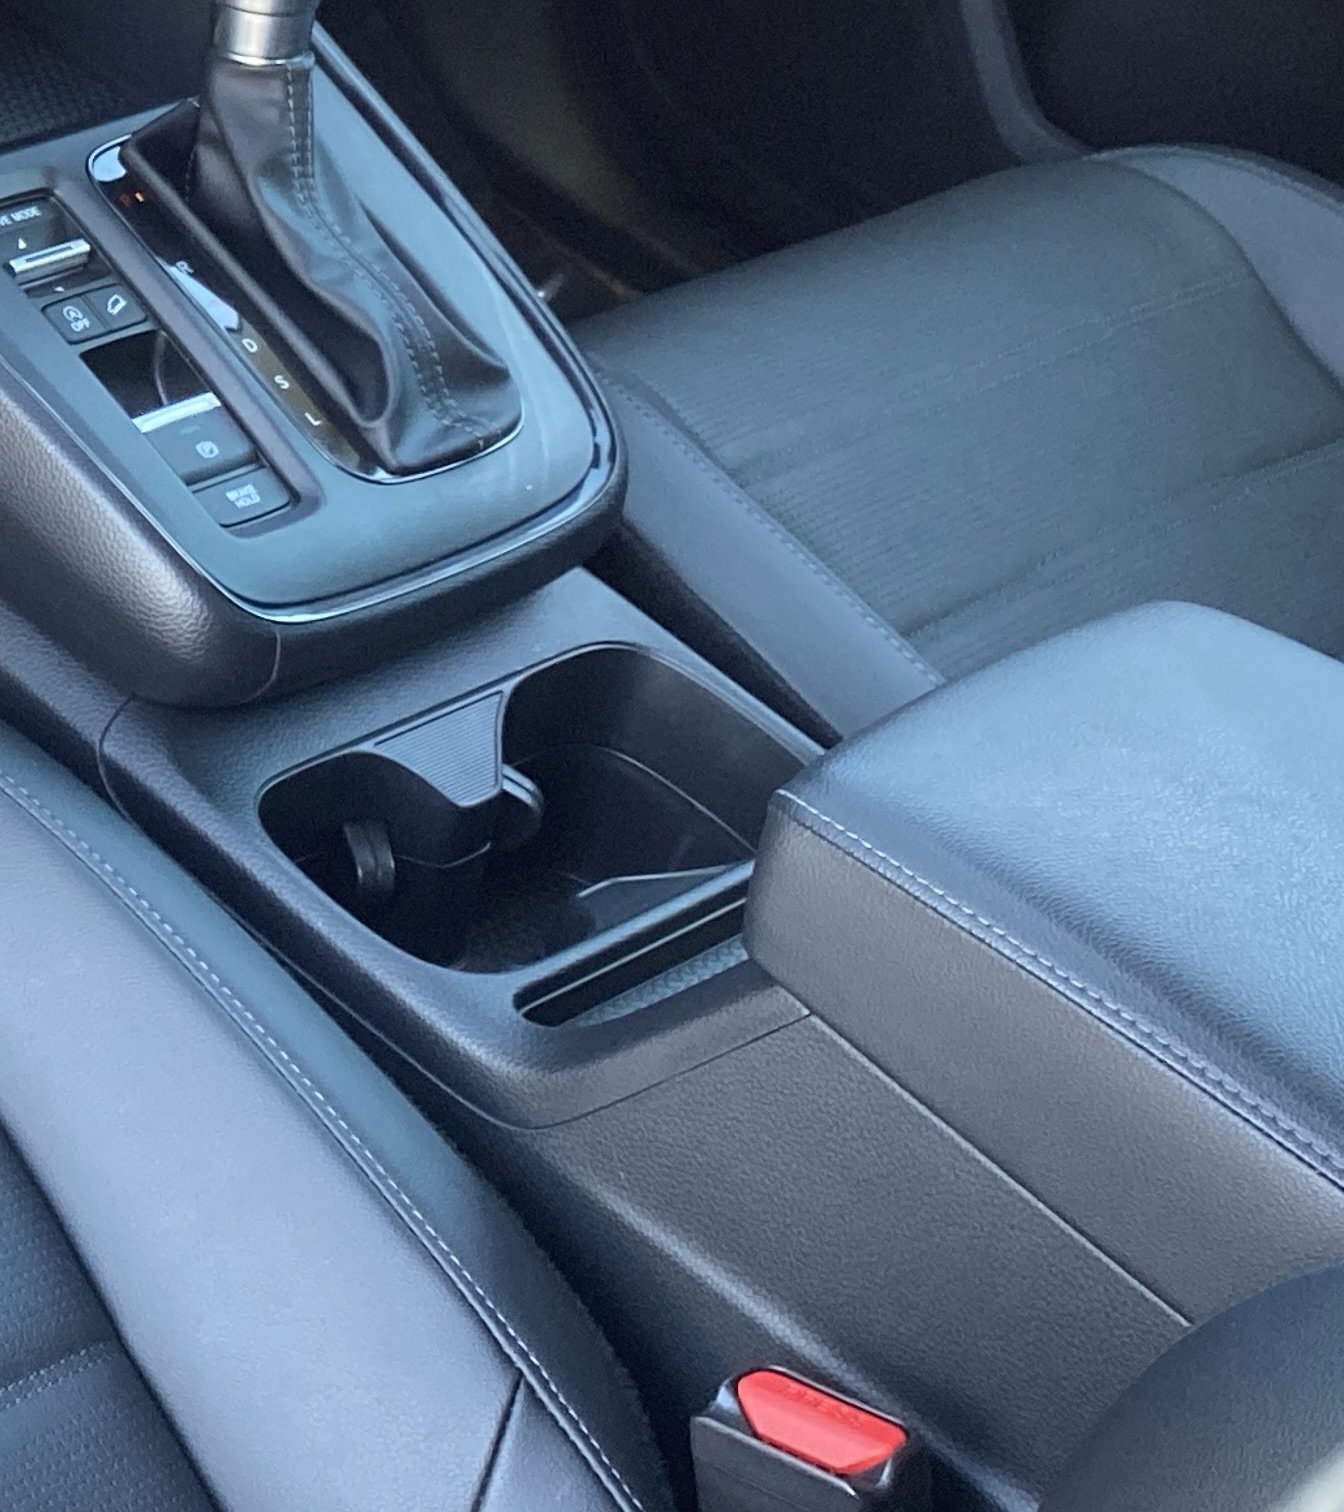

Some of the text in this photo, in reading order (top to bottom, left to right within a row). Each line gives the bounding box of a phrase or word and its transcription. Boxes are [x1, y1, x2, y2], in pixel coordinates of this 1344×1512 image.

[241, 337, 259, 353] D
[273, 374, 291, 389] S
[304, 412, 323, 426] L
